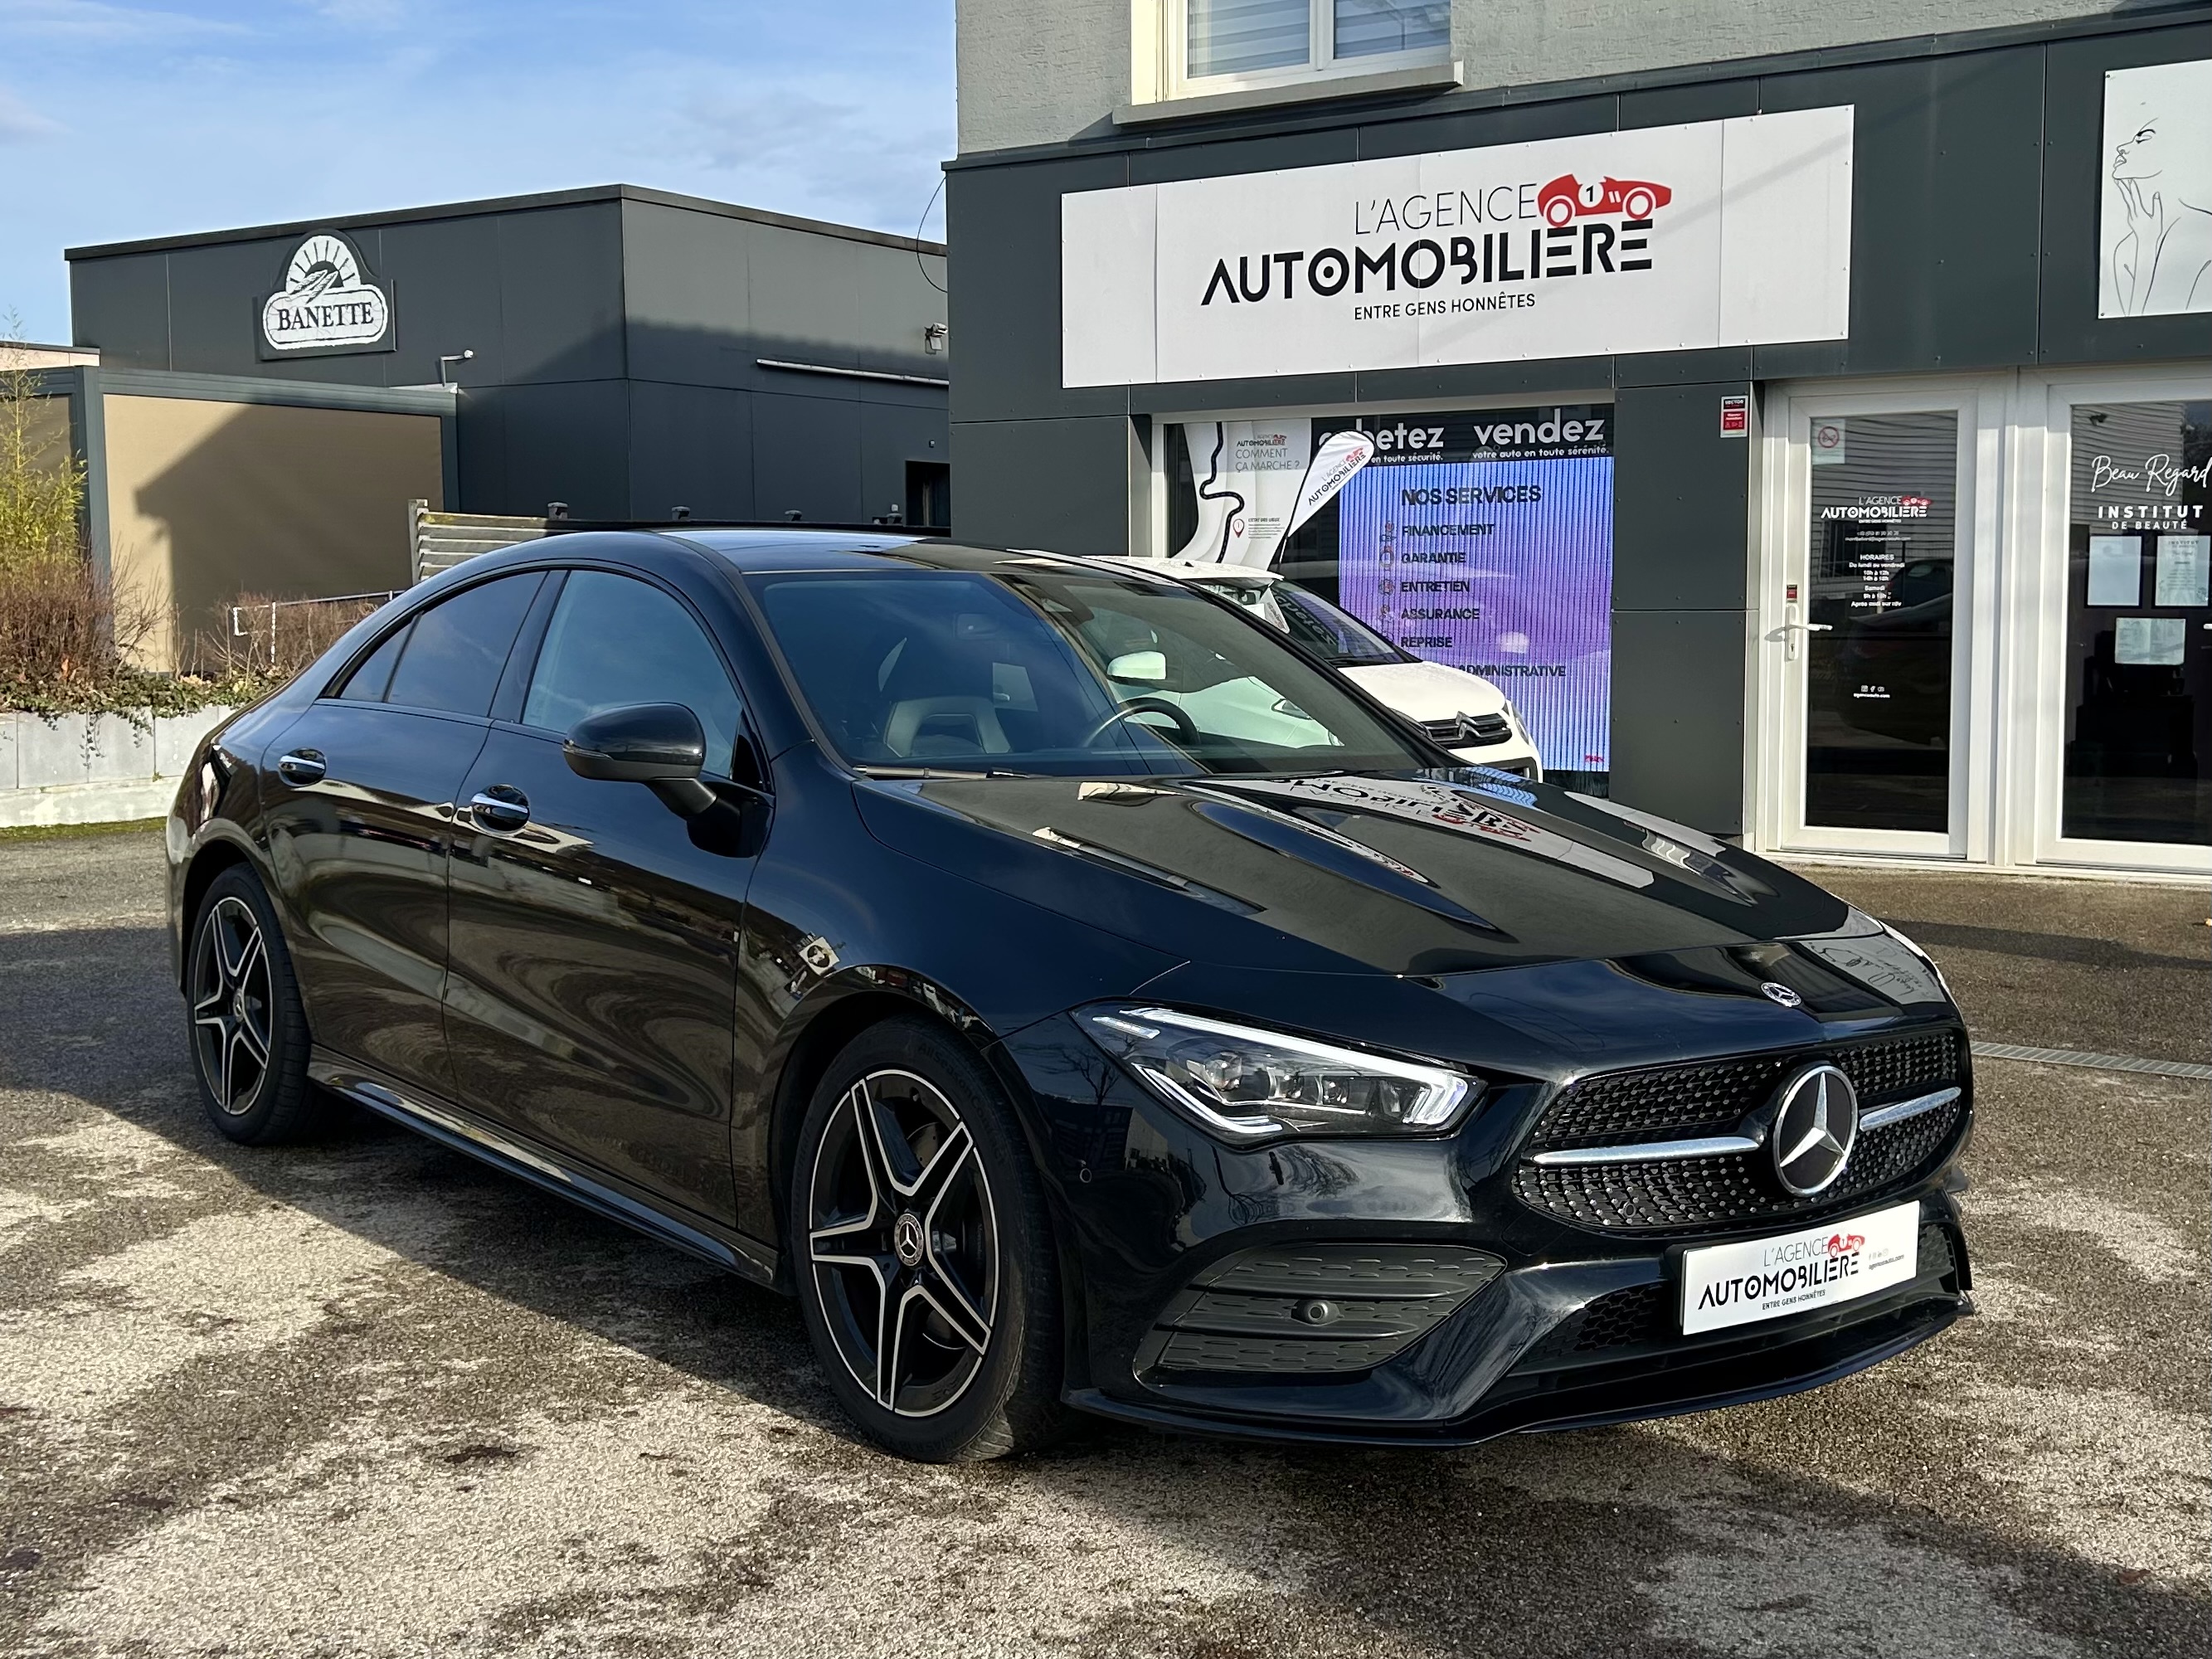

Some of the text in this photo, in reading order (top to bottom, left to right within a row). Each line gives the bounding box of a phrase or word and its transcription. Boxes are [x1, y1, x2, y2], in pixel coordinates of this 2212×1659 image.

[1356, 182, 1537, 235] L'AGENCE
[1201, 219, 1653, 305] AUTOMOBILIERE
[1354, 292, 1535, 320] ENTRE GENS HONNÊTES
[277, 301, 374, 331] BANETTE
[1473, 408, 1605, 445] vendez
[1235, 448, 1288, 459] COMMENT
[1408, 451, 1444, 462] sécurité.
[1499, 450, 1521, 458] auto
[1539, 448, 1564, 457] toute
[1235, 460, 1300, 473] ÇA MARCHE ?
[2091, 454, 2212, 496] Beau Regard
[1402, 485, 1542, 505] NOS SERVICES
[1858, 496, 1903, 505] L'AGENCE
[1821, 506, 1927, 518] AUTOMOBILIERE
[2098, 505, 2203, 518] INSTITUT
[1402, 524, 1495, 536] FINANCEMENT
[2136, 519, 2187, 530] BEAUTÉ
[1401, 552, 1466, 563] GARANTIE
[1401, 581, 1470, 592] ENTRETIEN
[1401, 608, 1480, 620] ASSURANCE
[1401, 637, 1452, 647] REPRISE
[1763, 1237, 1829, 1267] L'AGENCE
[1698, 1252, 1860, 1311] AUTOMOBILIERE
[1762, 1300, 1781, 1311] ENTRE
[1782, 1297, 1796, 1307] GENS
